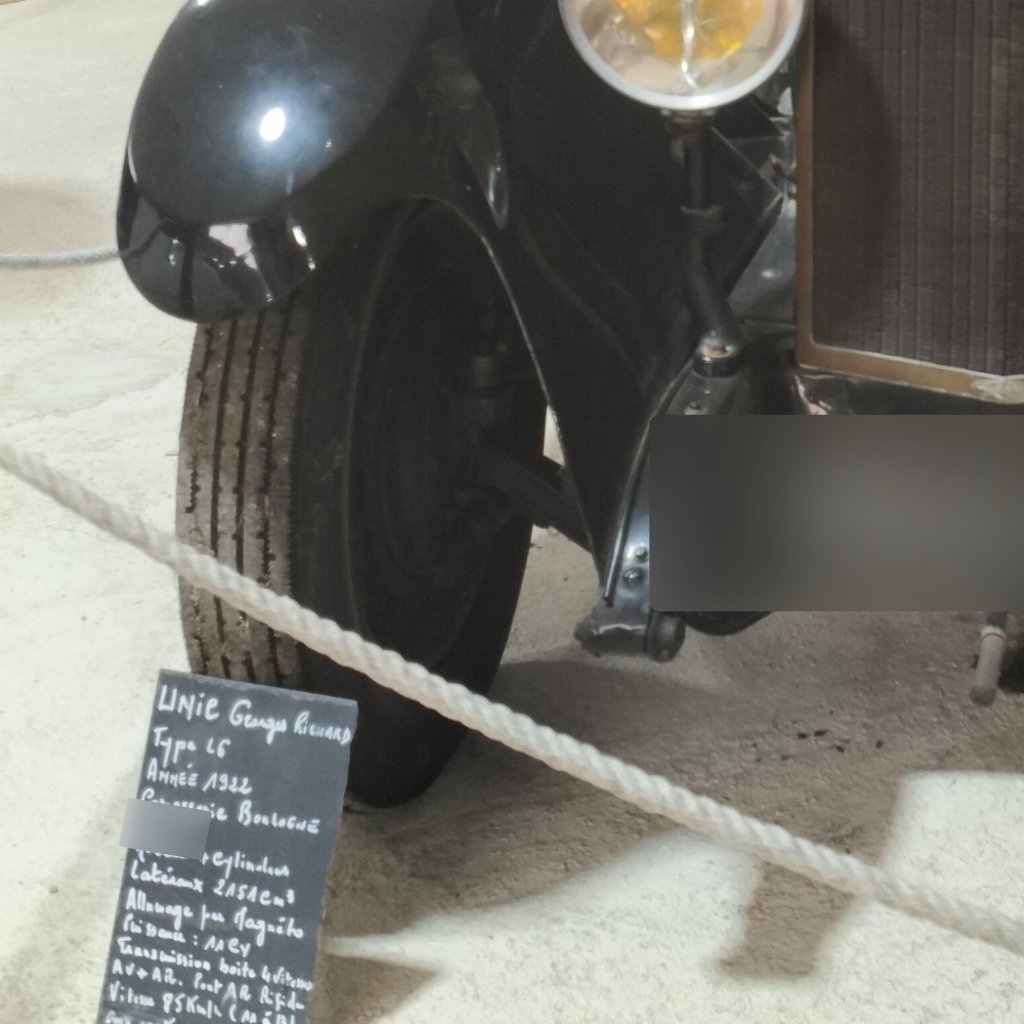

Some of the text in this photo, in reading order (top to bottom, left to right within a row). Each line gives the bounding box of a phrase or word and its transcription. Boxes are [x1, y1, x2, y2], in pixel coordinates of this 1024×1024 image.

[153, 726, 197, 768] Type
[202, 772, 252, 795] 1922
[200, 904, 225, 931] par
